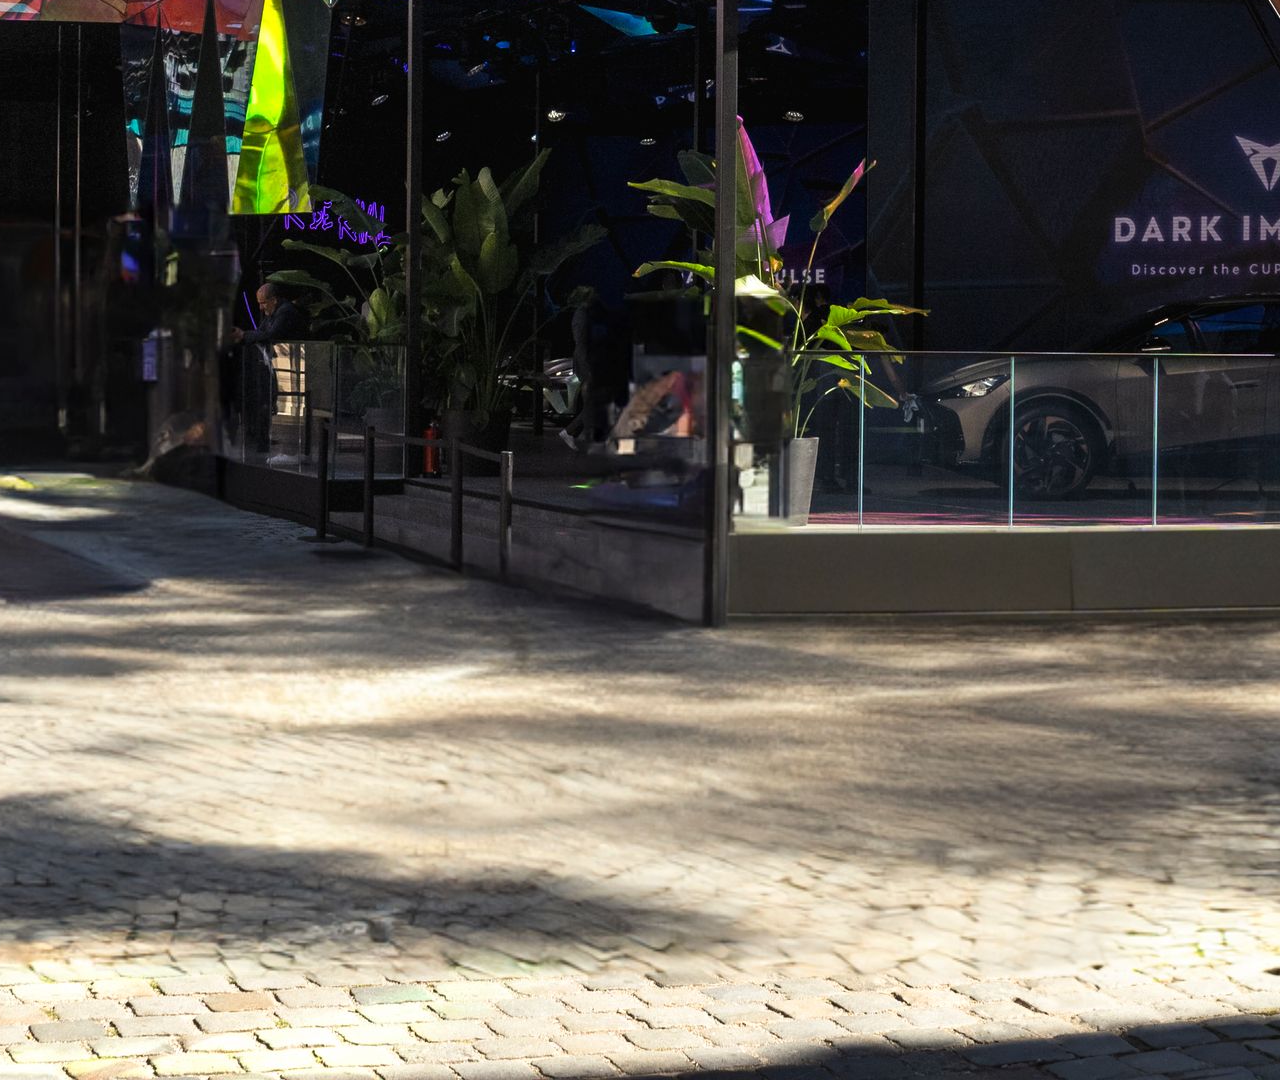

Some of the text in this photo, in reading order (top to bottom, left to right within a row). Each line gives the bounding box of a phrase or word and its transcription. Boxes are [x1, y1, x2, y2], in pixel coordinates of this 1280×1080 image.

[1114, 216, 1222, 243] DARK
[1131, 264, 1205, 276] Discover
[1213, 264, 1241, 275] the
